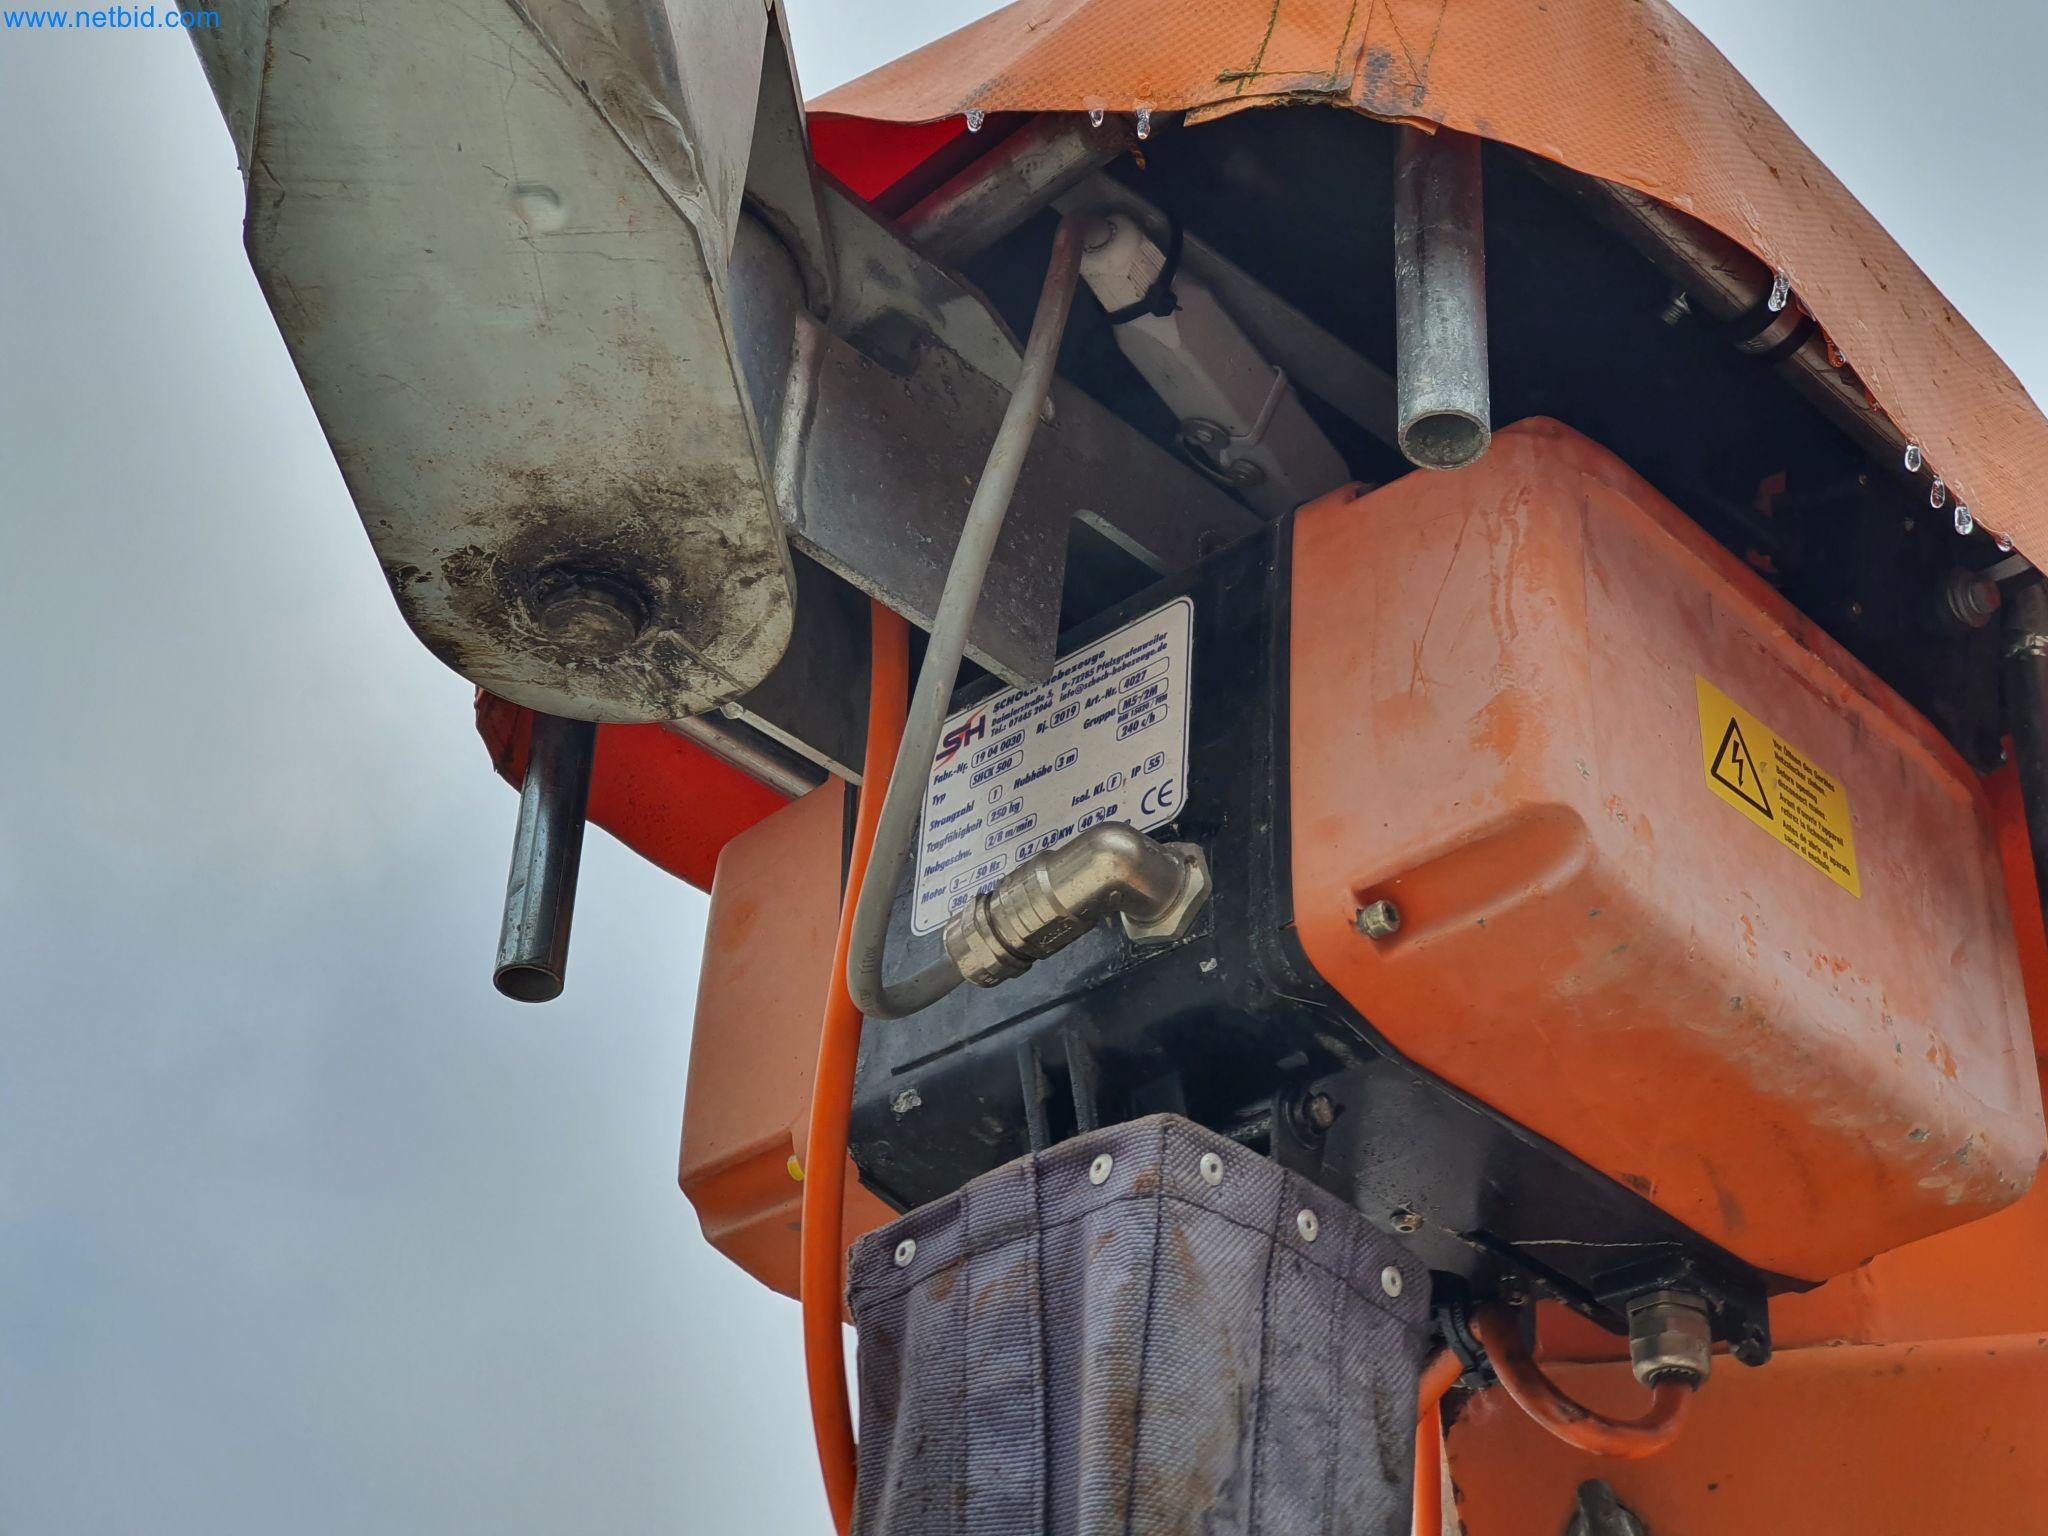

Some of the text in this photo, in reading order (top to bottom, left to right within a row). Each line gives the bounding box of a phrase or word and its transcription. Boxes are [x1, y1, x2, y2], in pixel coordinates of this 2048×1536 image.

[987, 745, 998, 757] 04
[1000, 734, 1021, 751] 0030
[1036, 720, 1048, 733] Bj.
[1054, 706, 1076, 724] 2019
[1085, 688, 1117, 709] Art.-Nr.
[1124, 670, 1147, 688] 4027
[1062, 668, 1094, 690] D-72285
[930, 800, 974, 831] Strangzahl
[1014, 766, 1052, 789] Hubhöhe
[1066, 754, 1076, 765] m
[1121, 720, 1139, 737] 240
[1141, 712, 1155, 727] c/h
[933, 793, 946, 805] Typ
[996, 758, 1012, 773] 500
[1084, 708, 1116, 729] Gruppe
[1141, 779, 1174, 815] CE
[928, 802, 1020, 852] Tragfähigkeit 250 kg
[988, 831, 1003, 846] 2/8
[1005, 819, 1032, 838] m/min
[1093, 782, 1105, 796] Kl.
[1131, 766, 1141, 778] IP
[1148, 756, 1160, 770] 55
[921, 887, 946, 904] Motor
[976, 866, 987, 879] 50
[990, 861, 1000, 873] Hz
[1019, 844, 1033, 861] 0,2
[1042, 833, 1056, 851] 0,8
[1059, 824, 1074, 839] KW
[1081, 816, 1092, 828] 40
[1106, 805, 1117, 817] ED
[952, 894, 967, 908] 380
